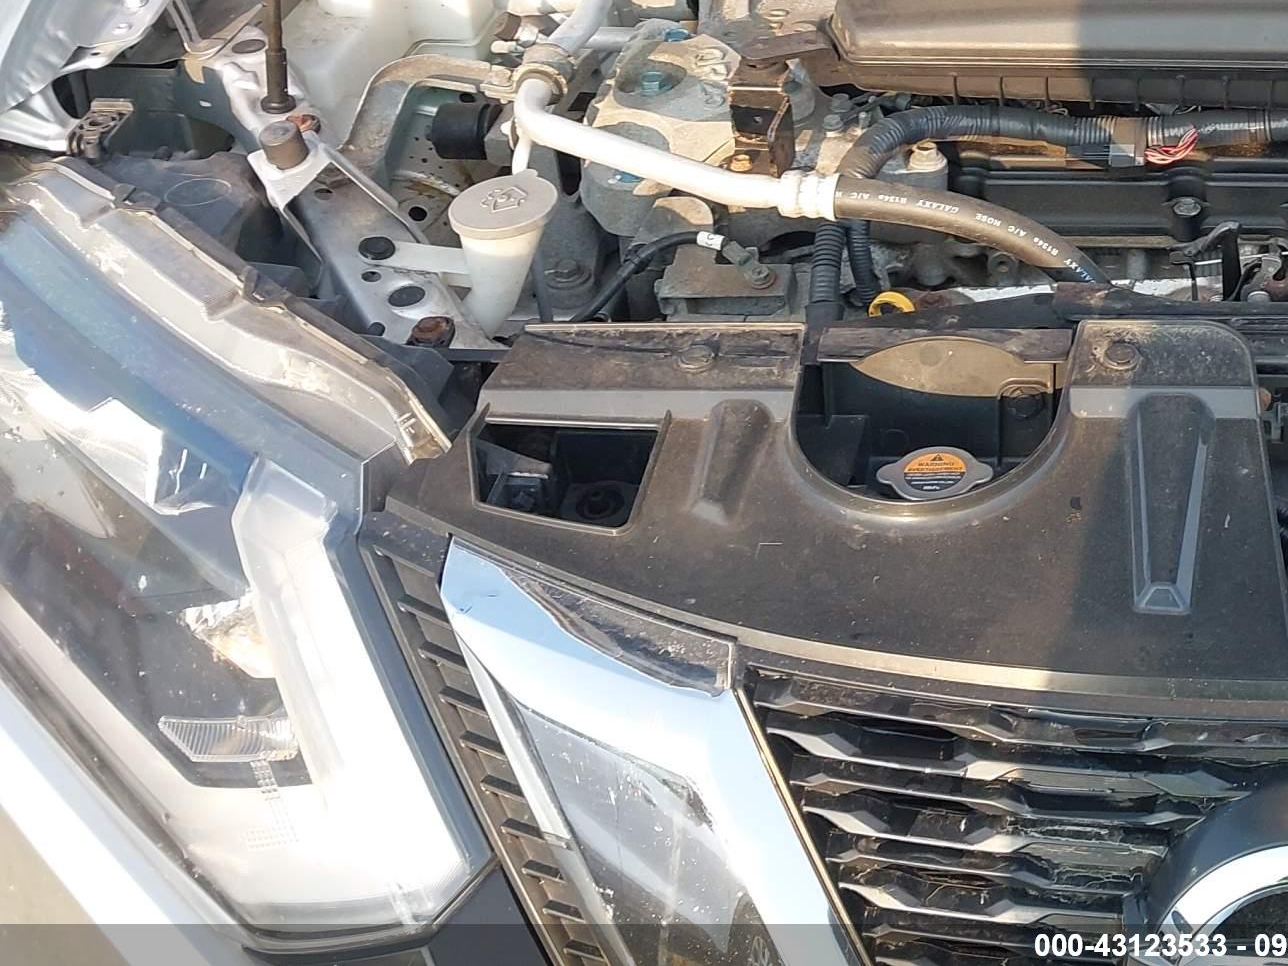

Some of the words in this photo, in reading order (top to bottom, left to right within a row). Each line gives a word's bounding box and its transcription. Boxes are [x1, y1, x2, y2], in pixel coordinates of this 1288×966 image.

[916, 199, 959, 214] GALAXY
[975, 213, 1002, 227] HOSE
[1007, 225, 1027, 237] A/C
